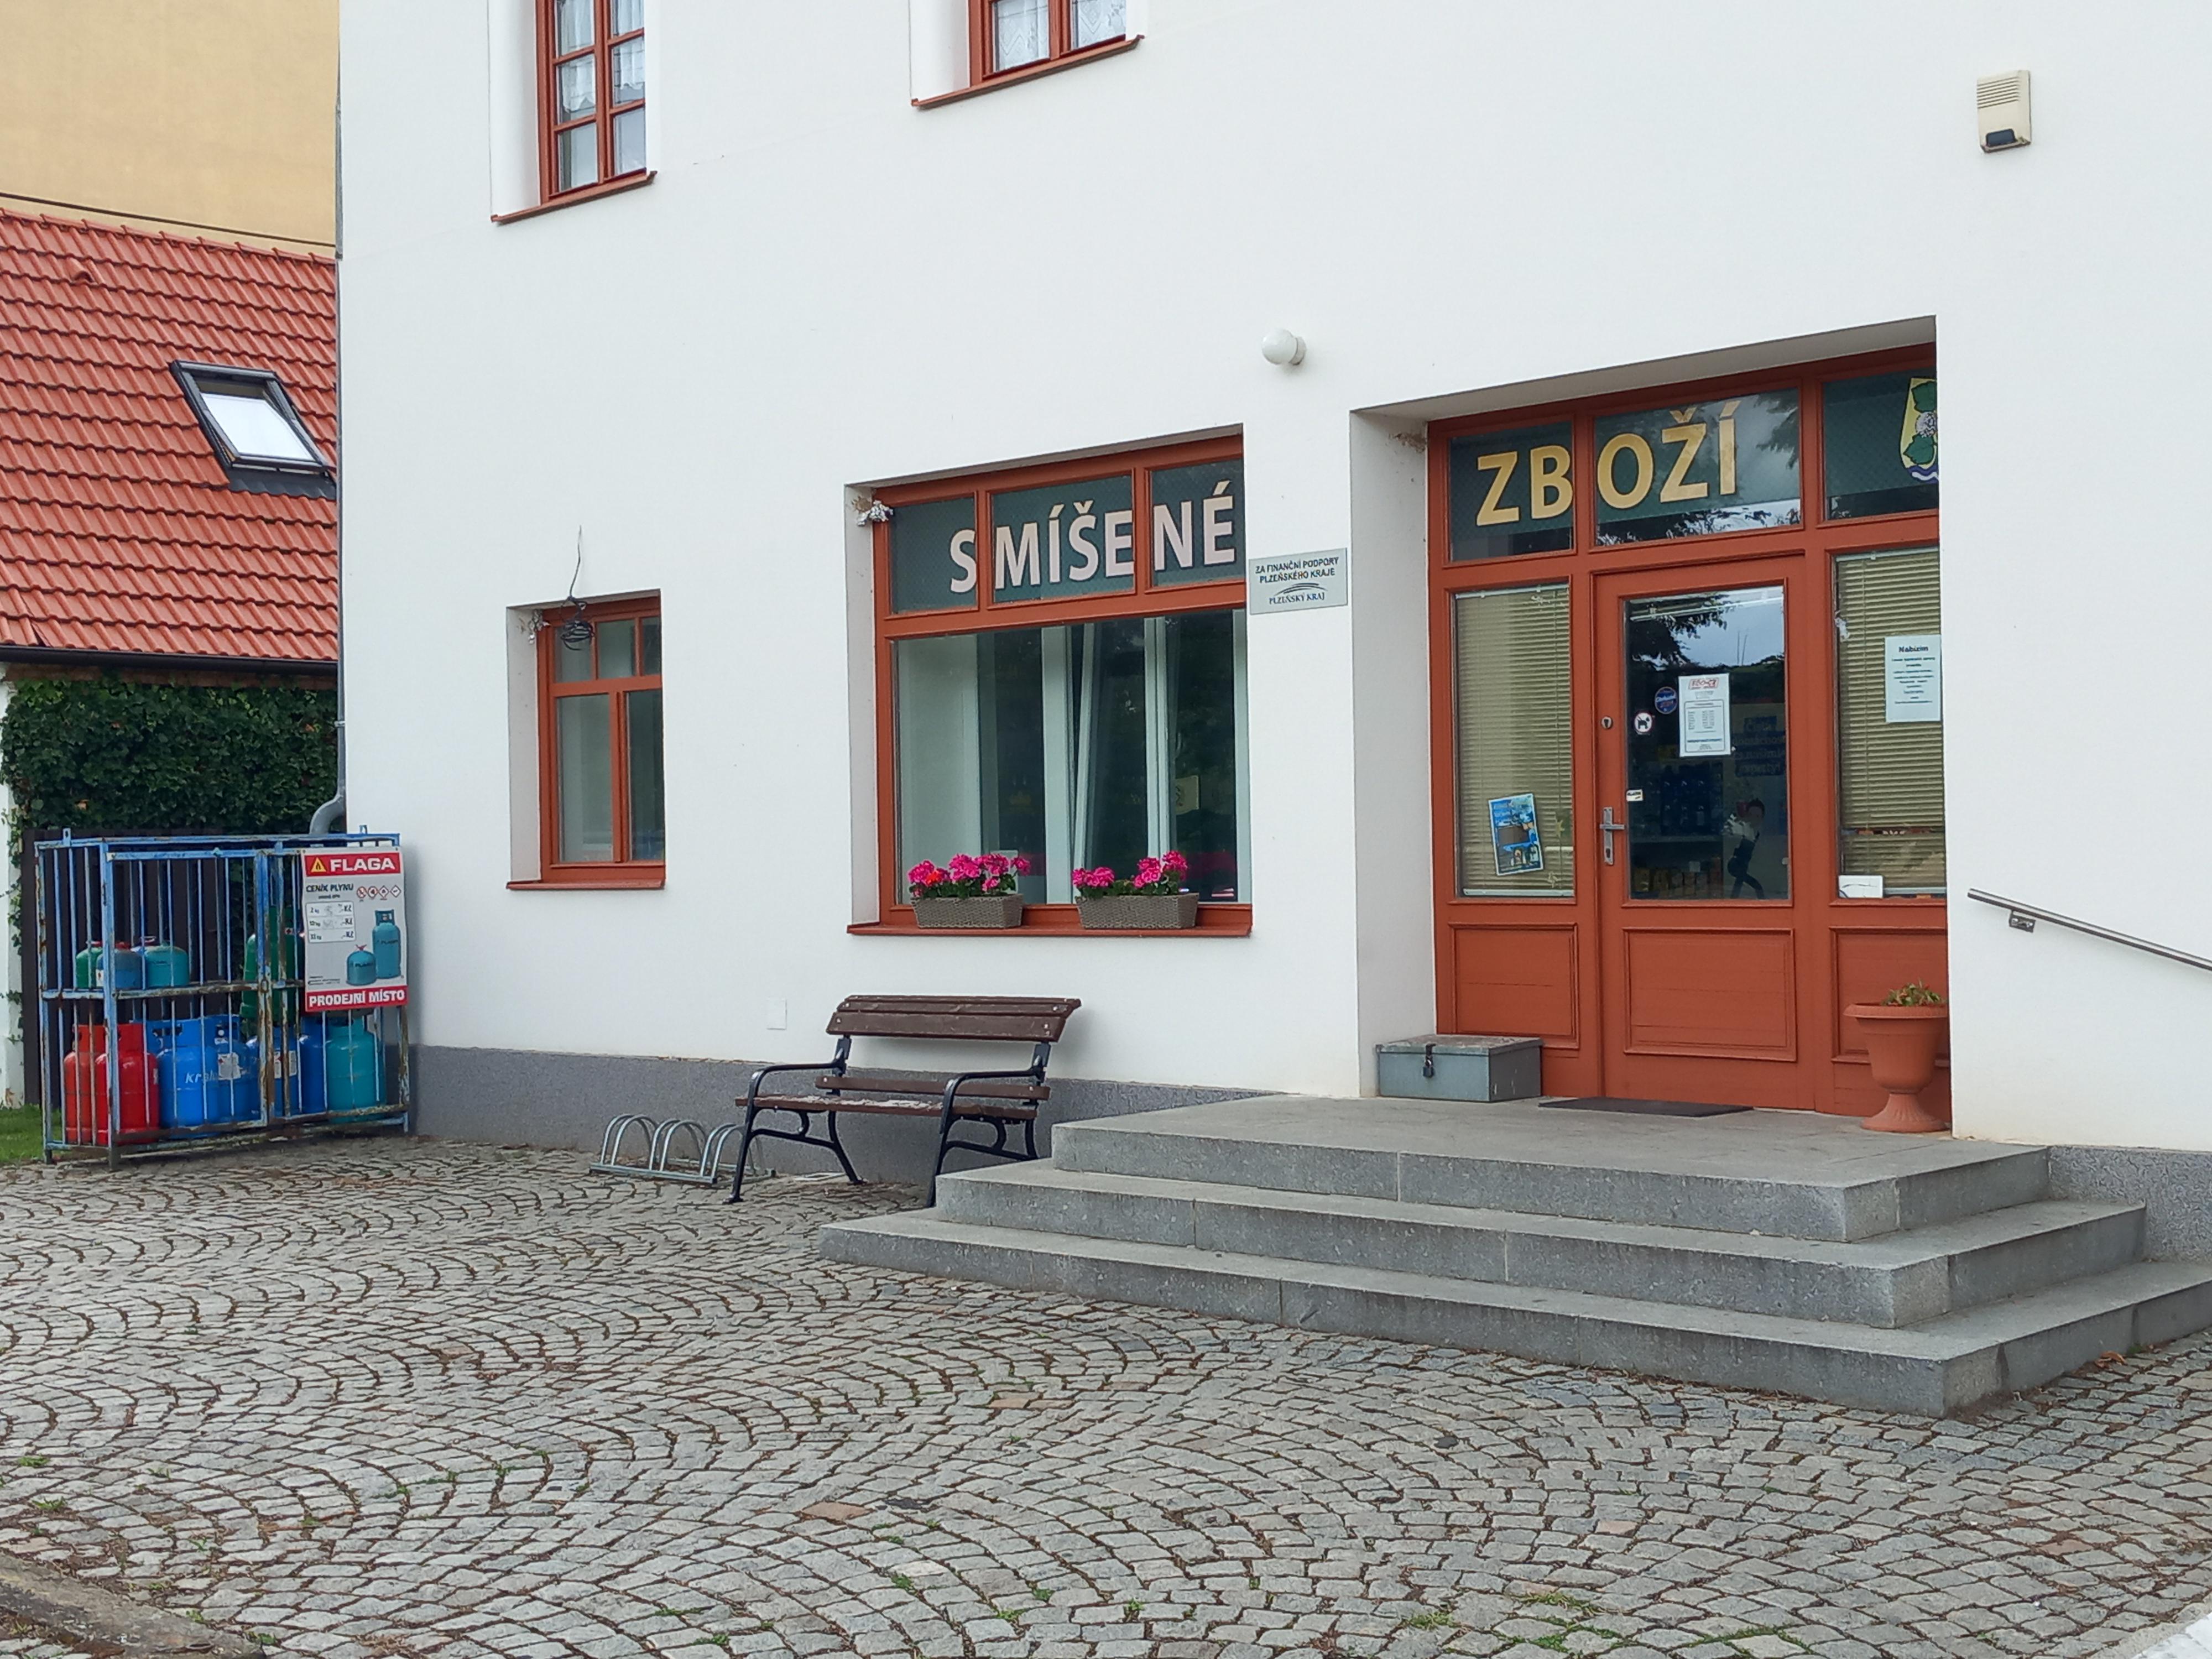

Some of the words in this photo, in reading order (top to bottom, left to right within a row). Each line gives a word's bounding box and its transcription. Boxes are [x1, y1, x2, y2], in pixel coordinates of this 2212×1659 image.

[1475, 399, 1741, 527] ZBOŽÍ
[948, 479, 1236, 594] SMÍŠENÉ
[1255, 565, 1265, 574] ZA
[1267, 560, 1301, 573] FINANČNÍ
[1303, 556, 1339, 569] PODPORY
[1260, 571, 1308, 583] PLZEŇSKÉHO
[1311, 568, 1335, 578] KRAJE
[1269, 592, 1305, 604] PLZEŇSKÝ
[1306, 592, 1324, 601] KRAJ
[330, 858, 395, 872] FLAGA
[309, 990, 366, 1007] PRODEJNÍ
[368, 989, 405, 1003] MÍSTO
